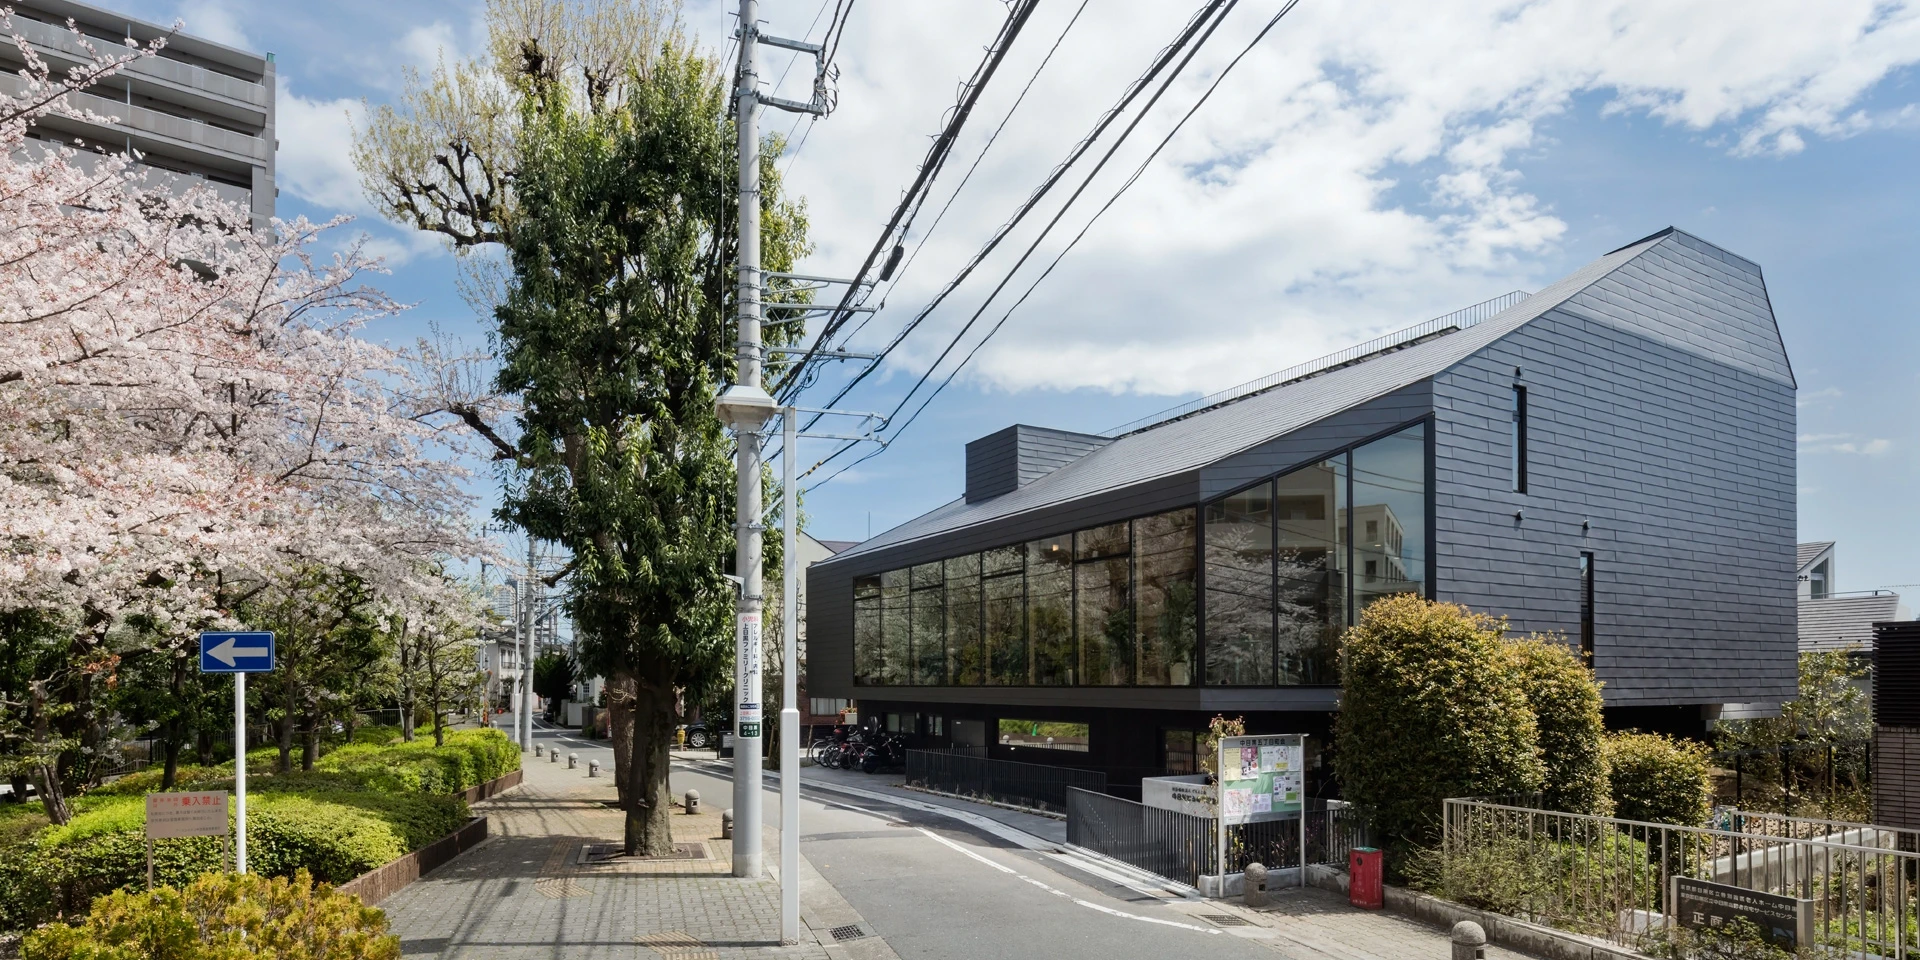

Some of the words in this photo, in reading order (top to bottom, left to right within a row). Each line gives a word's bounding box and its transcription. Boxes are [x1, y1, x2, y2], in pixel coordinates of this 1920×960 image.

[1239, 738, 1286, 746] 中目黒五丁目町会
[182, 796, 221, 807] 乗入禁止
